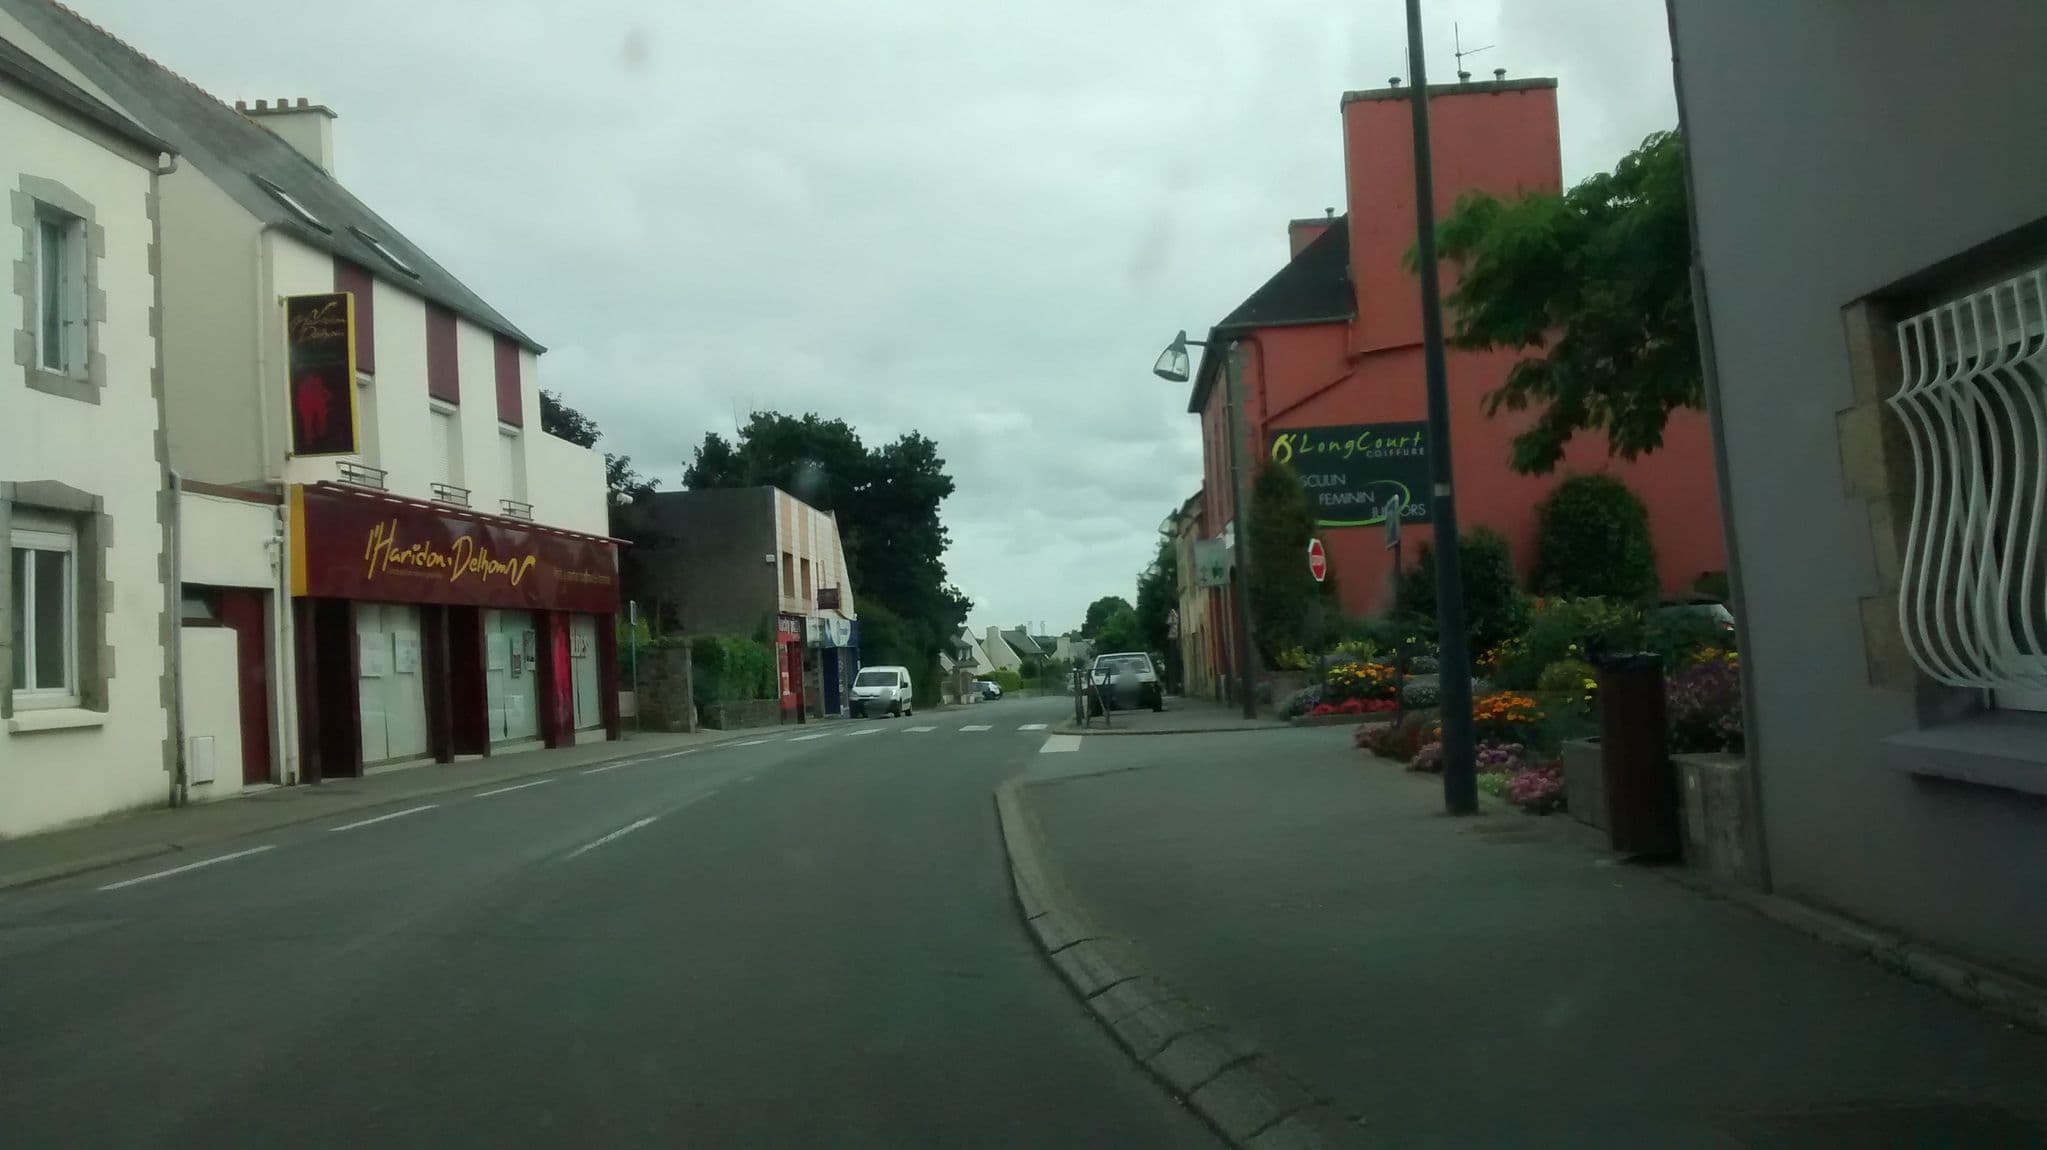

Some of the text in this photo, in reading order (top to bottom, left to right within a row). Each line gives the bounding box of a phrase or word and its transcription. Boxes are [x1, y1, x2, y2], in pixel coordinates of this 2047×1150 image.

[1366, 447, 1425, 459] COIFFURE
[1299, 474, 1347, 488] SCULIN
[1318, 491, 1375, 506] FEMININ
[1371, 503, 1426, 519] JUORS
